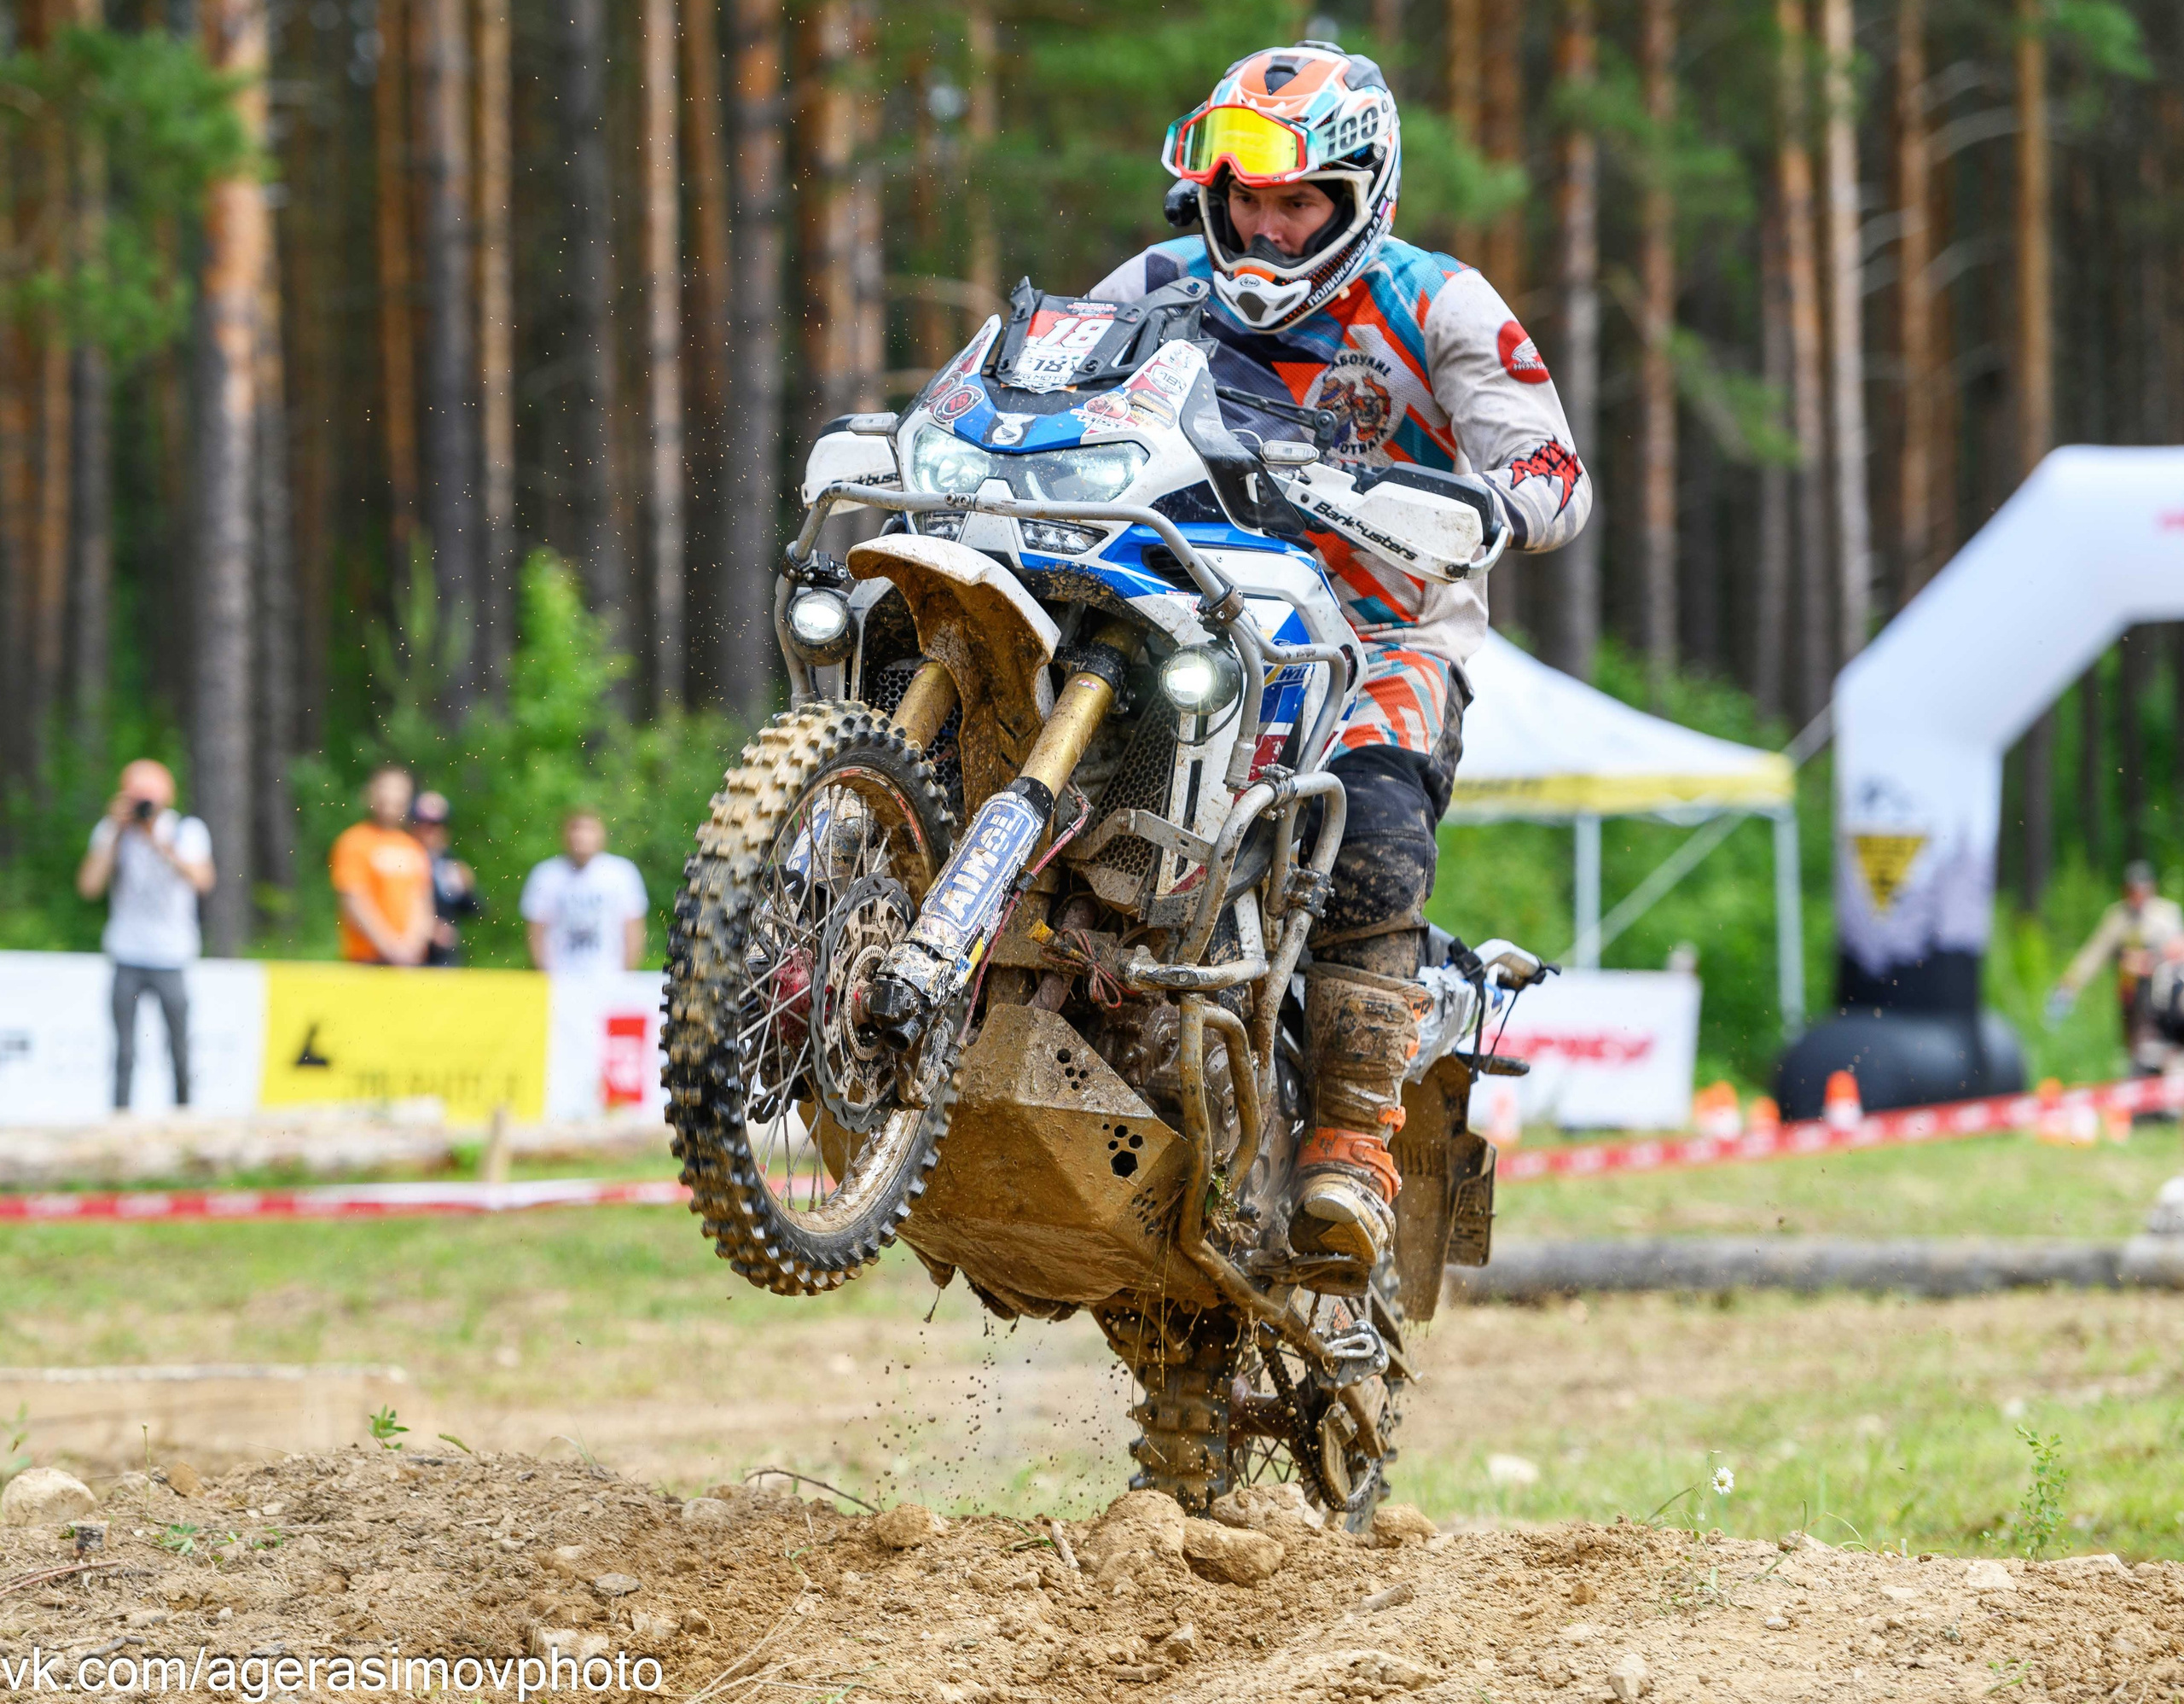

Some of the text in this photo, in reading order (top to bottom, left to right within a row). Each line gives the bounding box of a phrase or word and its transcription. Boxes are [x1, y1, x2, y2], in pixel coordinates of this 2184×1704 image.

[1037, 317, 1114, 348] 18
[1034, 358, 1067, 372] 18
[1513, 361, 1548, 371] HOND
[1035, 374, 1068, 382] MOTO
[949, 393, 969, 412] 18
[939, 813, 1025, 922] AIMOL
